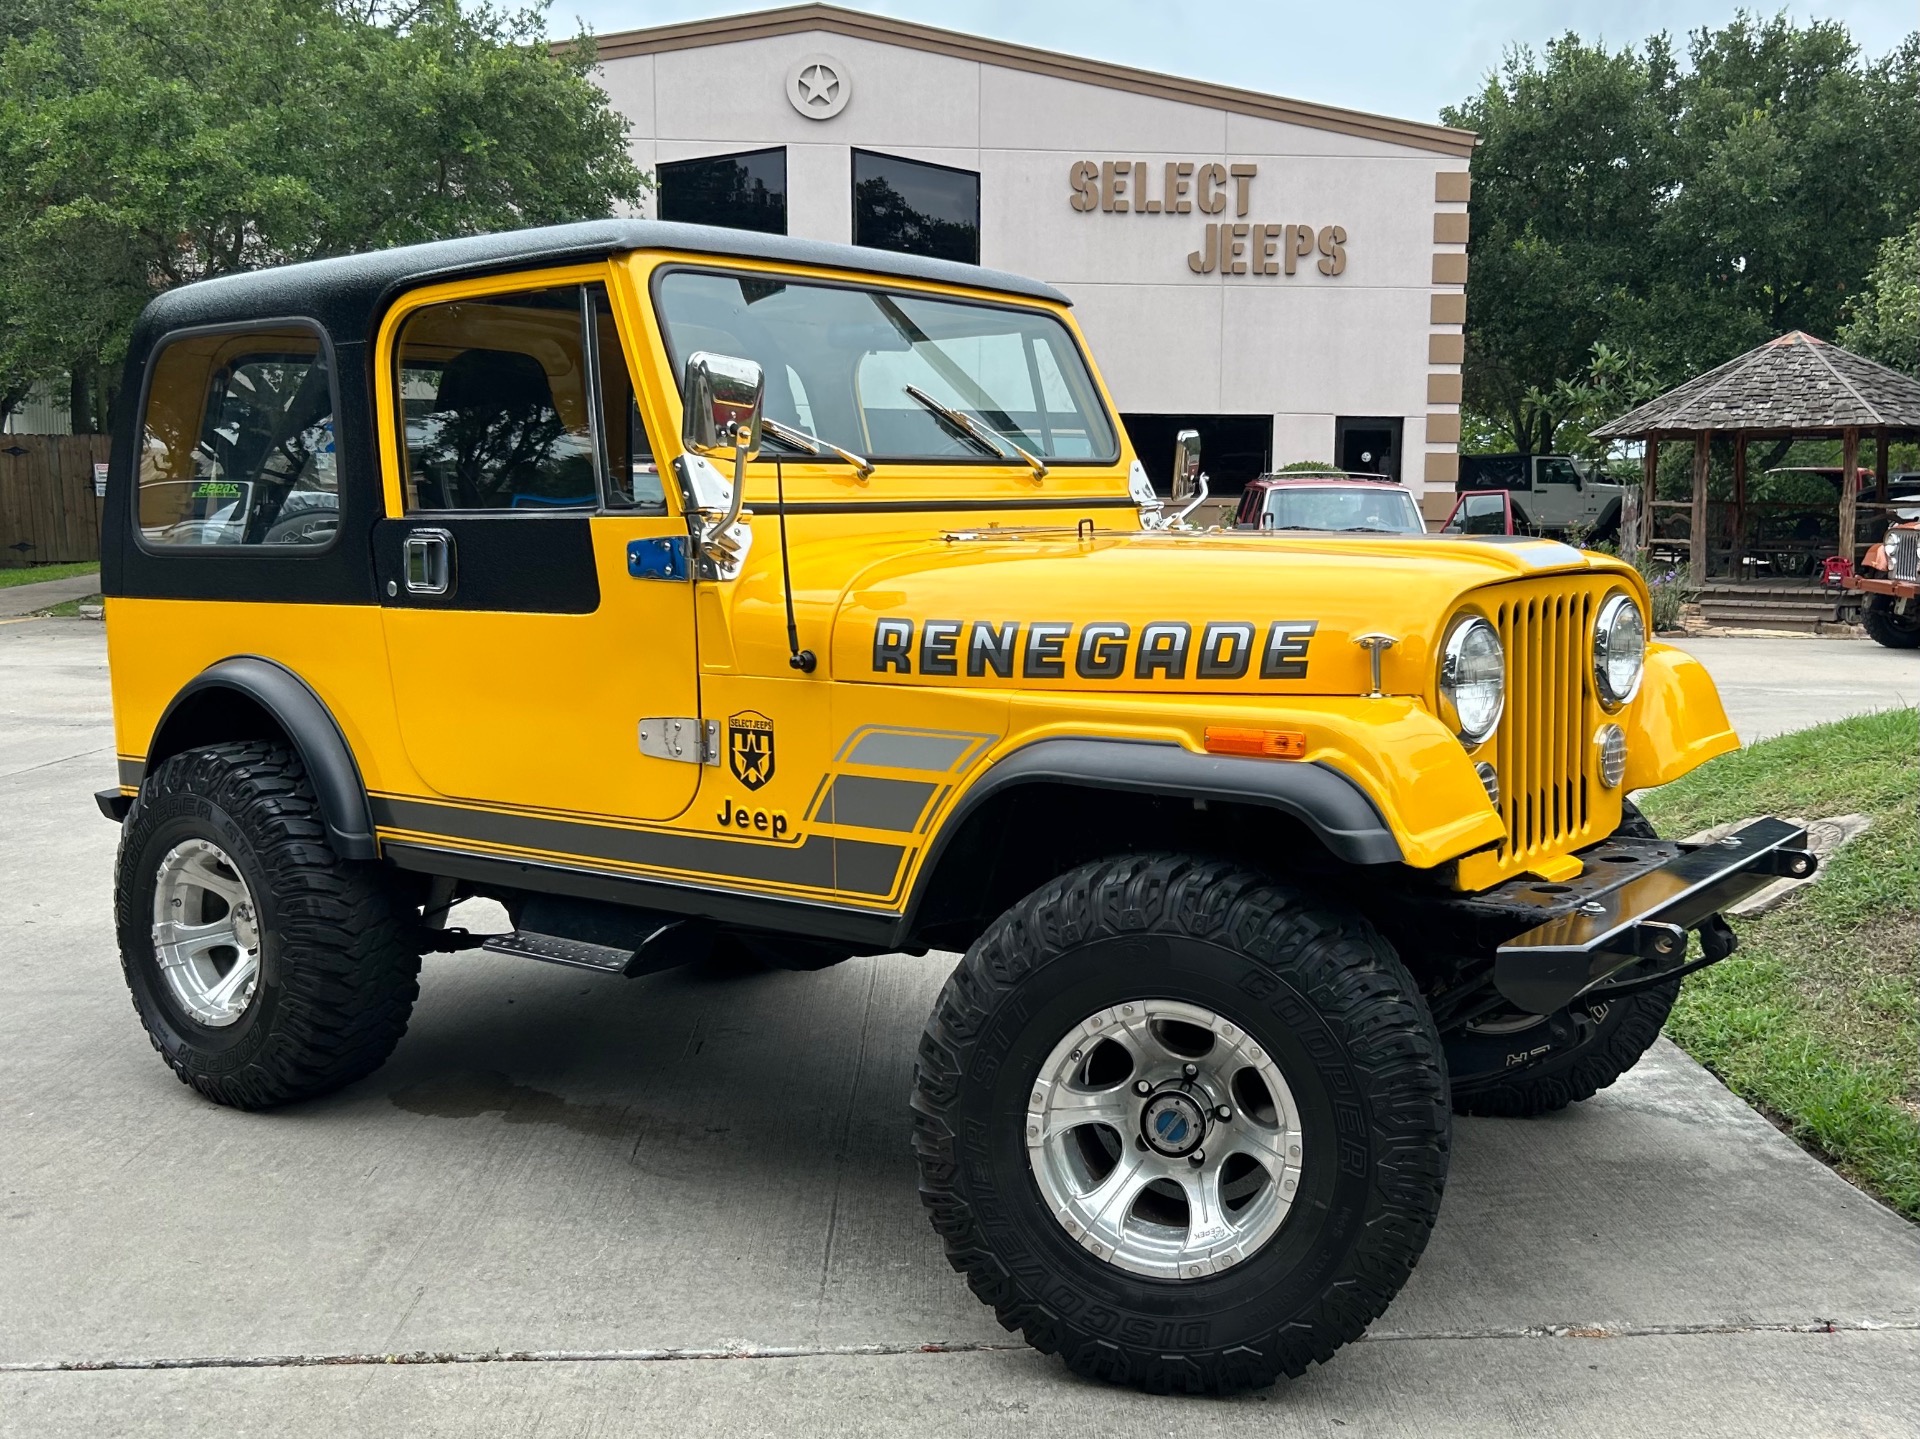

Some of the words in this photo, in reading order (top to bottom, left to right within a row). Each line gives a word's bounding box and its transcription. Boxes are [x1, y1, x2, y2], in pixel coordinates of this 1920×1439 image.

[1069, 160, 1258, 217] SELECT
[1188, 223, 1348, 276] JEEPS
[873, 618, 1317, 680] RENEGADE
[730, 718, 752, 729] SELECT
[753, 720, 772, 730] JEEPS
[717, 797, 788, 838] Jeep
[222, 821, 265, 879] STT
[178, 1023, 261, 1072] COOPER
[972, 990, 1030, 1089] STT
[1237, 969, 1369, 1179] COOPER
[963, 1117, 1212, 1347] DISCOVERER
